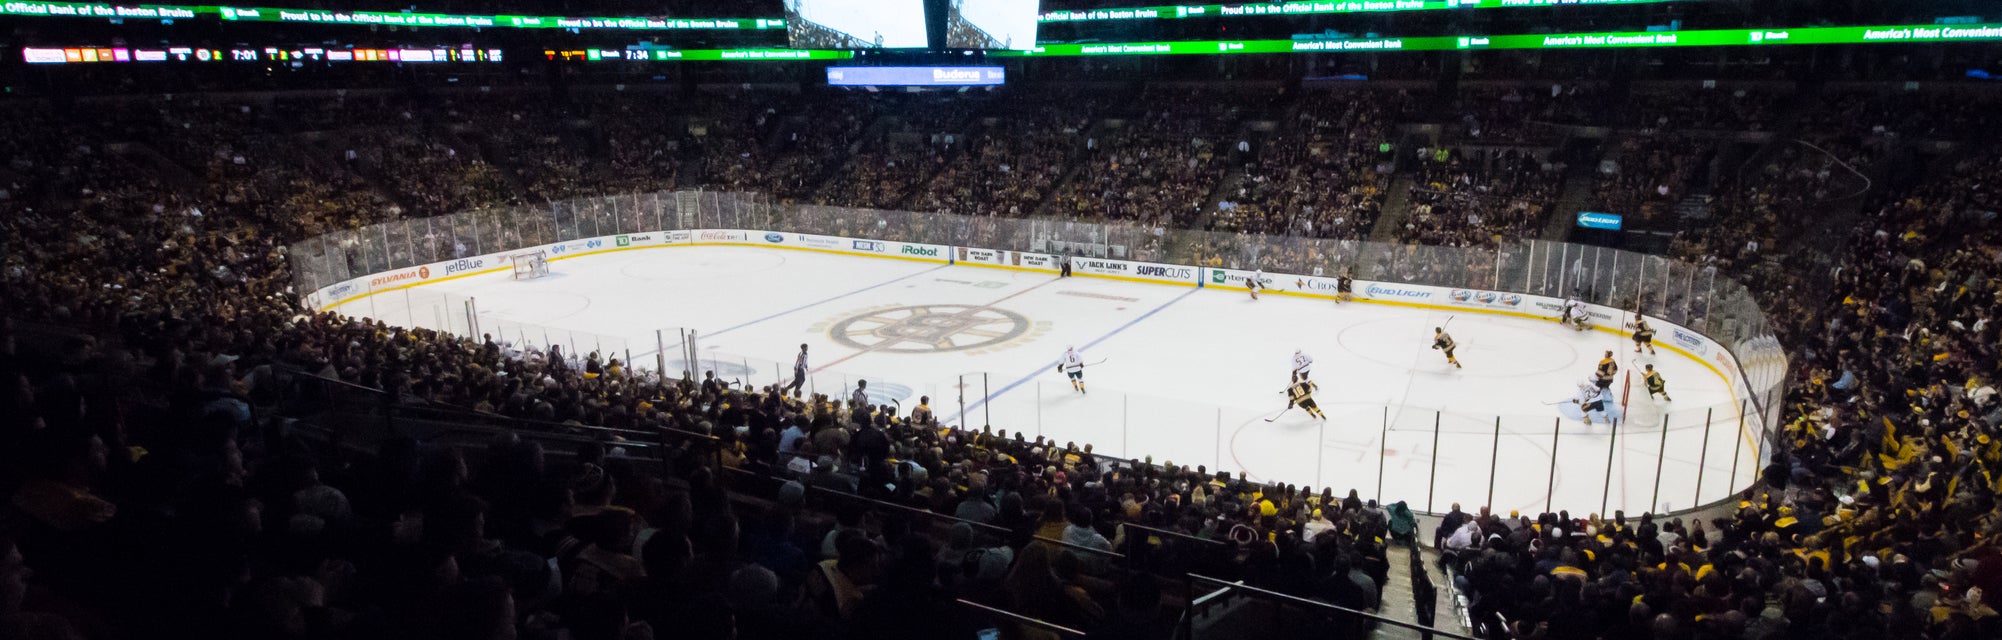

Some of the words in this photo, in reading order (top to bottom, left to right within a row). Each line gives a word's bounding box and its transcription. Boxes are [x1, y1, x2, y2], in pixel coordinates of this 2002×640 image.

[5, 3, 47, 14] Official
[48, 4, 76, 15] Bank
[78, 5, 92, 15] of
[93, 6, 115, 15] the
[116, 6, 157, 16] Boston
[158, 7, 195, 17] Bruins
[1221, 6, 1243, 15] Proud
[1244, 6, 1254, 14] to
[1255, 5, 1267, 14] be
[1268, 4, 1282, 13] the
[1283, 3, 1312, 13] Official
[1314, 2, 1335, 12] Bank
[1336, 2, 1349, 11] of
[1349, 1, 1362, 10] the
[1364, 0, 1394, 10] Boston
[1396, 0, 1424, 8] Bruins
[280, 11, 308, 20] Proud
[309, 12, 320, 20] to
[321, 12, 333, 21] be
[334, 13, 351, 22] the
[352, 14, 383, 23] Official
[384, 15, 405, 24] Bank
[406, 15, 417, 24] of
[418, 16, 433, 24] the
[434, 16, 465, 25] Boston
[466, 17, 493, 25] Bruins
[1045, 11, 1069, 20] Official
[1070, 11, 1087, 20] Bank
[1098, 10, 1109, 19] the
[1110, 9, 1133, 18] Boston
[1134, 8, 1157, 17] Bruins
[557, 19, 581, 27] Proud
[582, 19, 592, 27] to
[593, 19, 603, 27] be
[604, 19, 618, 27] the
[618, 19, 646, 28] Official
[677, 20, 689, 28] the
[690, 20, 714, 28] Boston
[715, 20, 739, 28] Bruins
[1863, 29, 1911, 39] America's
[1912, 28, 1940, 38] Most
[1941, 26, 2002, 37] Convenient
[1292, 41, 1324, 50] America's
[1325, 41, 1343, 49] Most
[1344, 40, 1383, 49] Convenient
[1384, 39, 1402, 48] Bank
[1543, 36, 1582, 46] America's
[1583, 36, 1605, 45] Most
[1607, 34, 1654, 44] Convenient
[1655, 34, 1677, 43] Bank
[232, 49, 257, 60] 7:01
[1081, 45, 1107, 53] America's
[1108, 45, 1123, 53] Most
[1123, 44, 1155, 52] Convenient
[1156, 44, 1170, 52] Bank
[212, 50, 222, 60] 2
[625, 50, 648, 60] 7:34
[934, 69, 981, 79] Buderus
[631, 235, 651, 243] Bank
[901, 244, 937, 256] iRobot
[445, 258, 483, 276] jetBlue
[1105, 263, 1127, 271] LINK'S
[1136, 265, 1190, 279] SUPERCUTS
[371, 271, 417, 286] SYLVANIA
[1369, 286, 1396, 296] BUD
[1398, 288, 1432, 299] LIGHT
